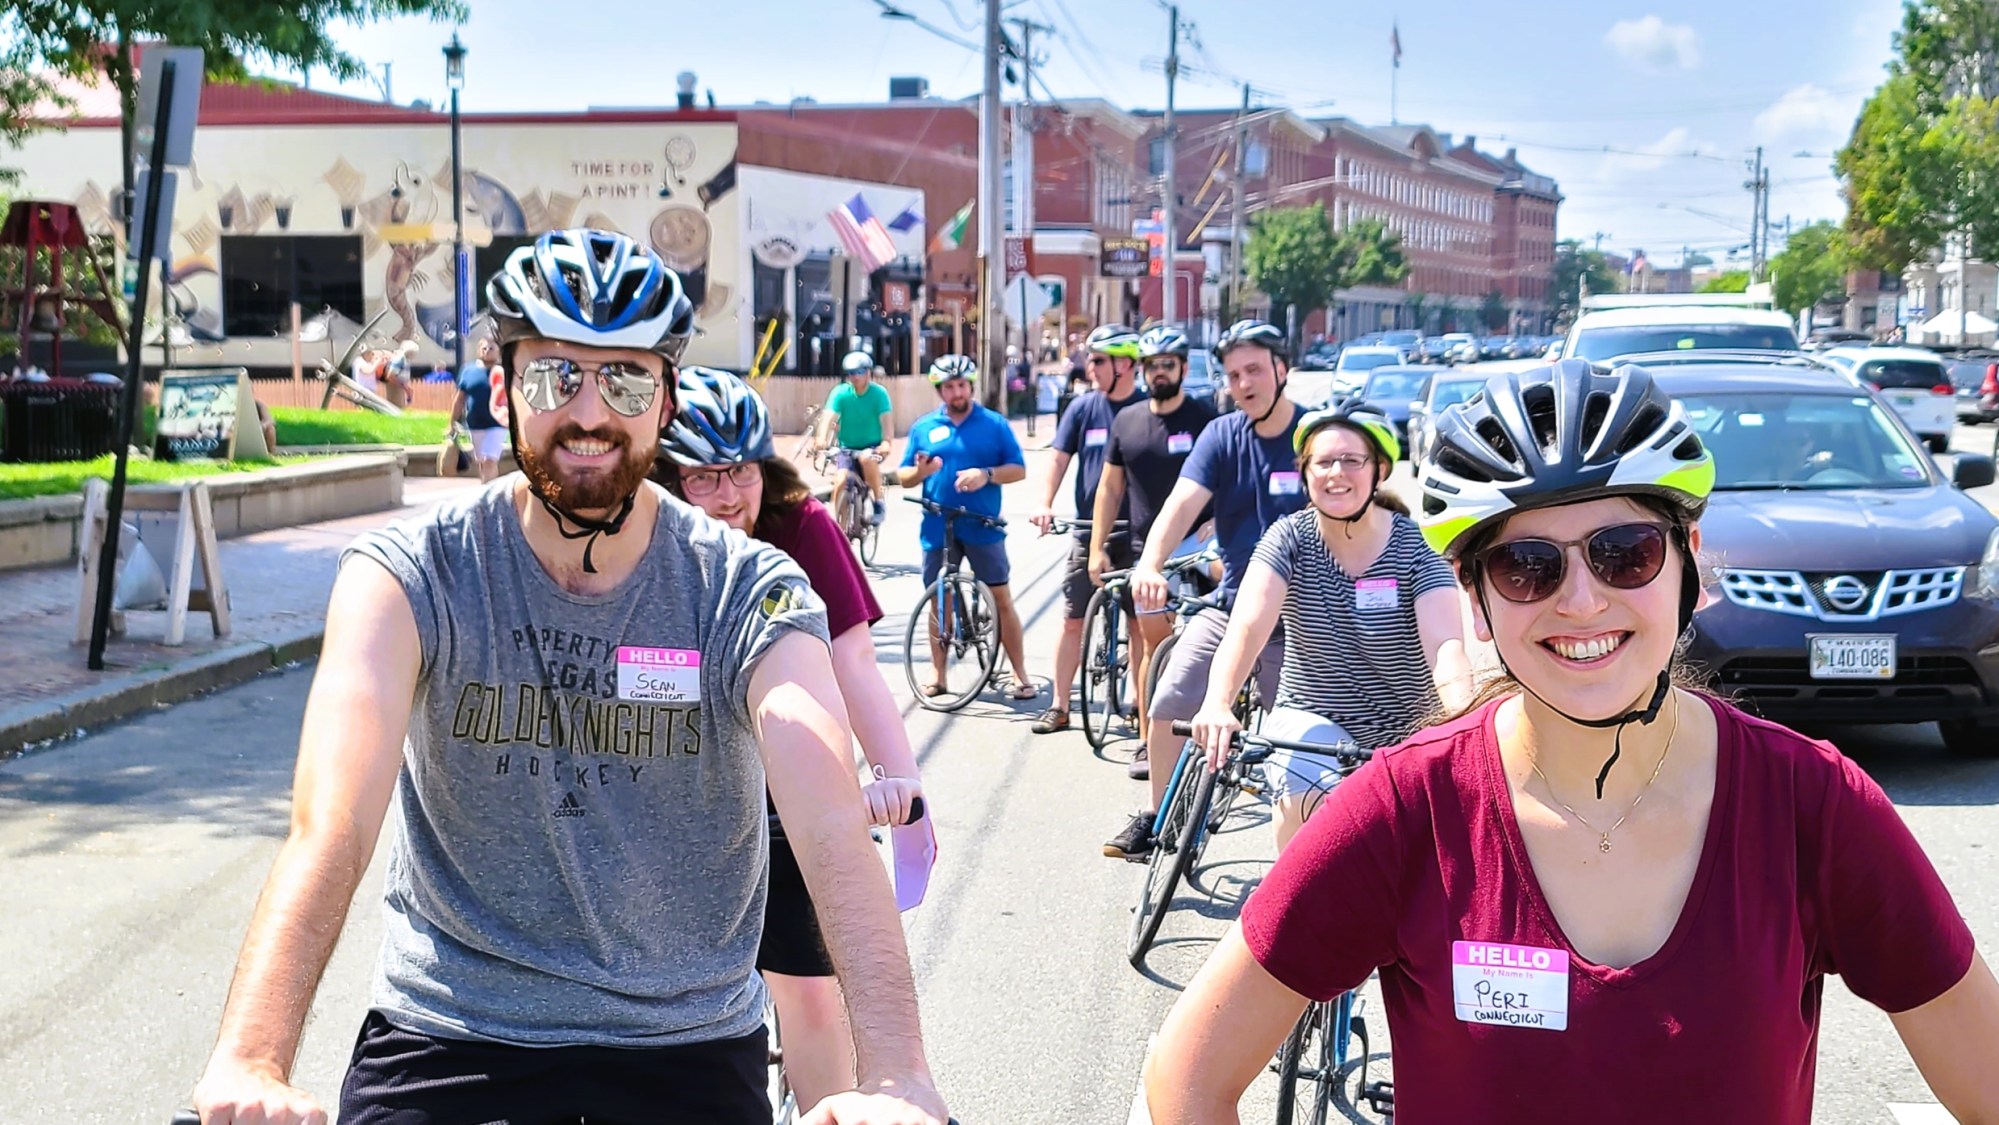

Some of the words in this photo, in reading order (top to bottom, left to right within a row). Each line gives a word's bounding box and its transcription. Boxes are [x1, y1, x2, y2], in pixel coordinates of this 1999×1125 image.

[571, 162, 613, 175] TIME
[620, 162, 654, 175] FOR
[582, 184, 593, 197] A
[511, 624, 619, 664] PPERTY
[629, 649, 688, 665] HELLO
[546, 660, 618, 699] EGAS
[635, 672, 676, 692] SEAN
[564, 693, 702, 759] KNIGHTS
[495, 753, 644, 789] HOCKEY
[553, 807, 586, 818] adidas
[1468, 945, 1551, 970] HELLO
[1482, 968, 1495, 977] My
[1498, 969, 1523, 979] Name
[1526, 971, 1534, 979] Is
[1473, 979, 1529, 1010] PERI
[1474, 1010, 1545, 1026] CONNECTICUT
